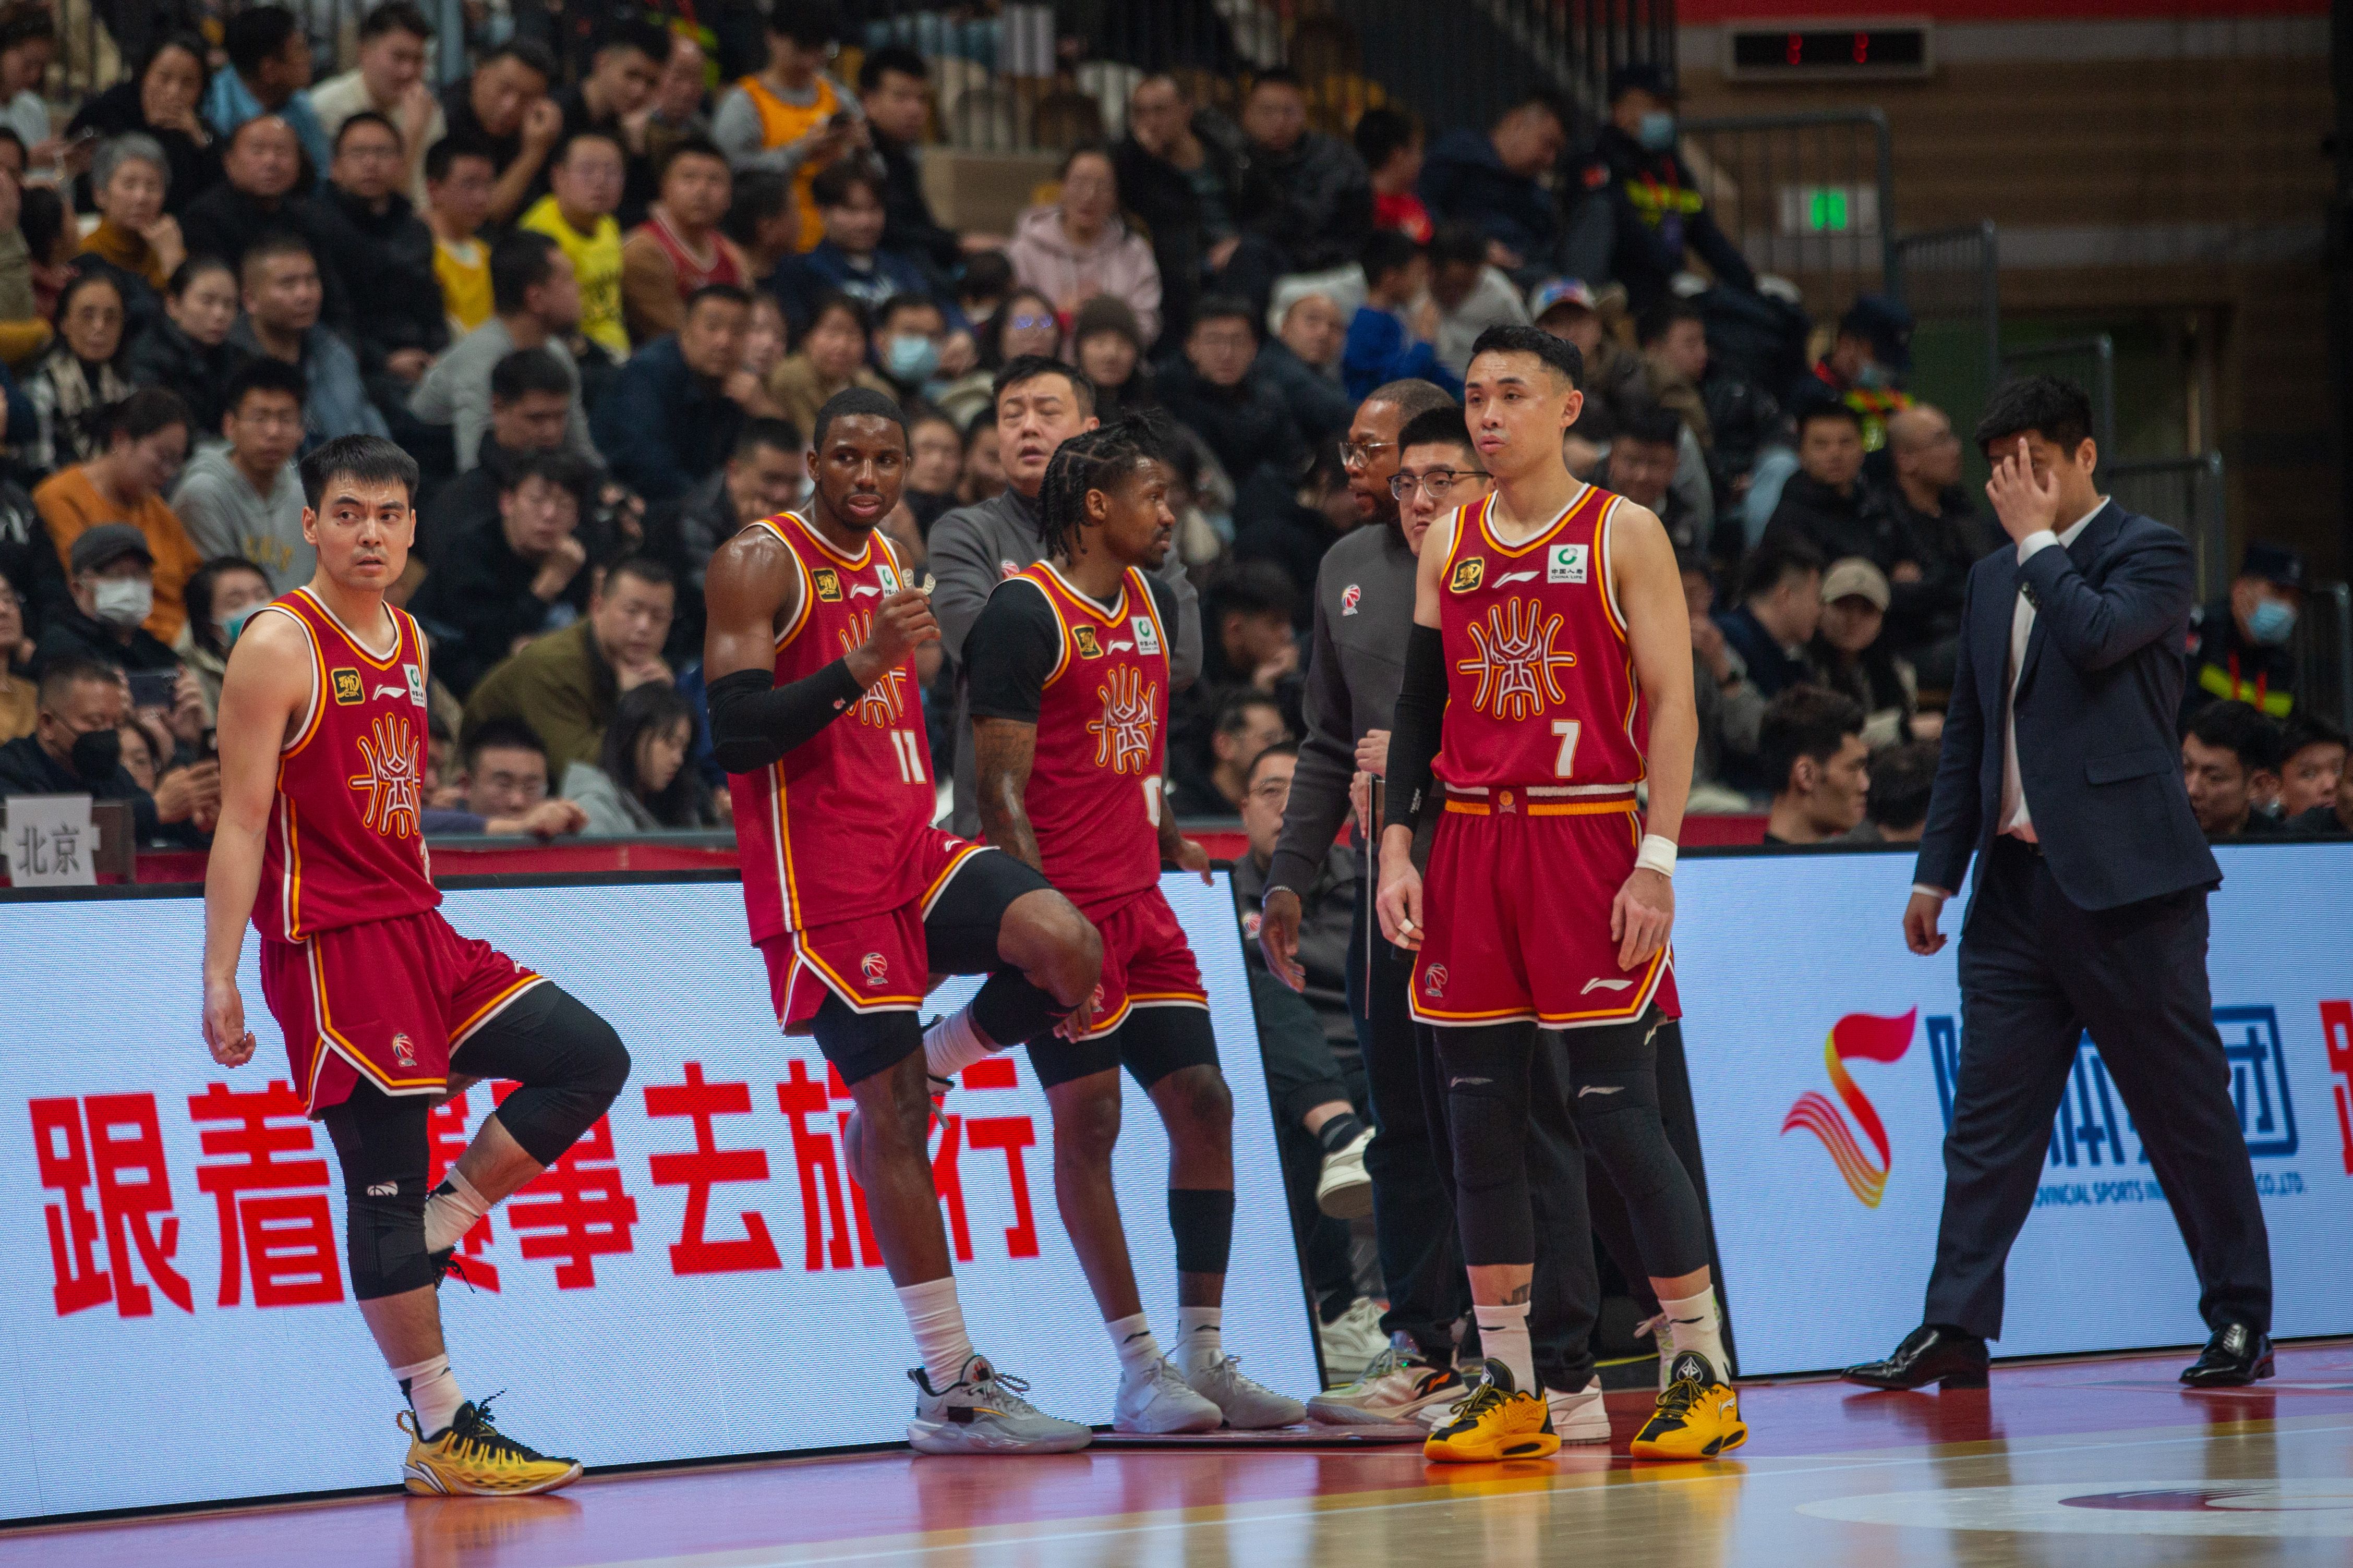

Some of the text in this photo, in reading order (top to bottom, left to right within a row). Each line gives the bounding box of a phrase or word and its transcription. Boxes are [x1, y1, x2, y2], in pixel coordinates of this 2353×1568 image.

[891, 730, 927, 784] 11
[1551, 719, 1581, 779] 7
[16, 821, 80, 877] 北京
